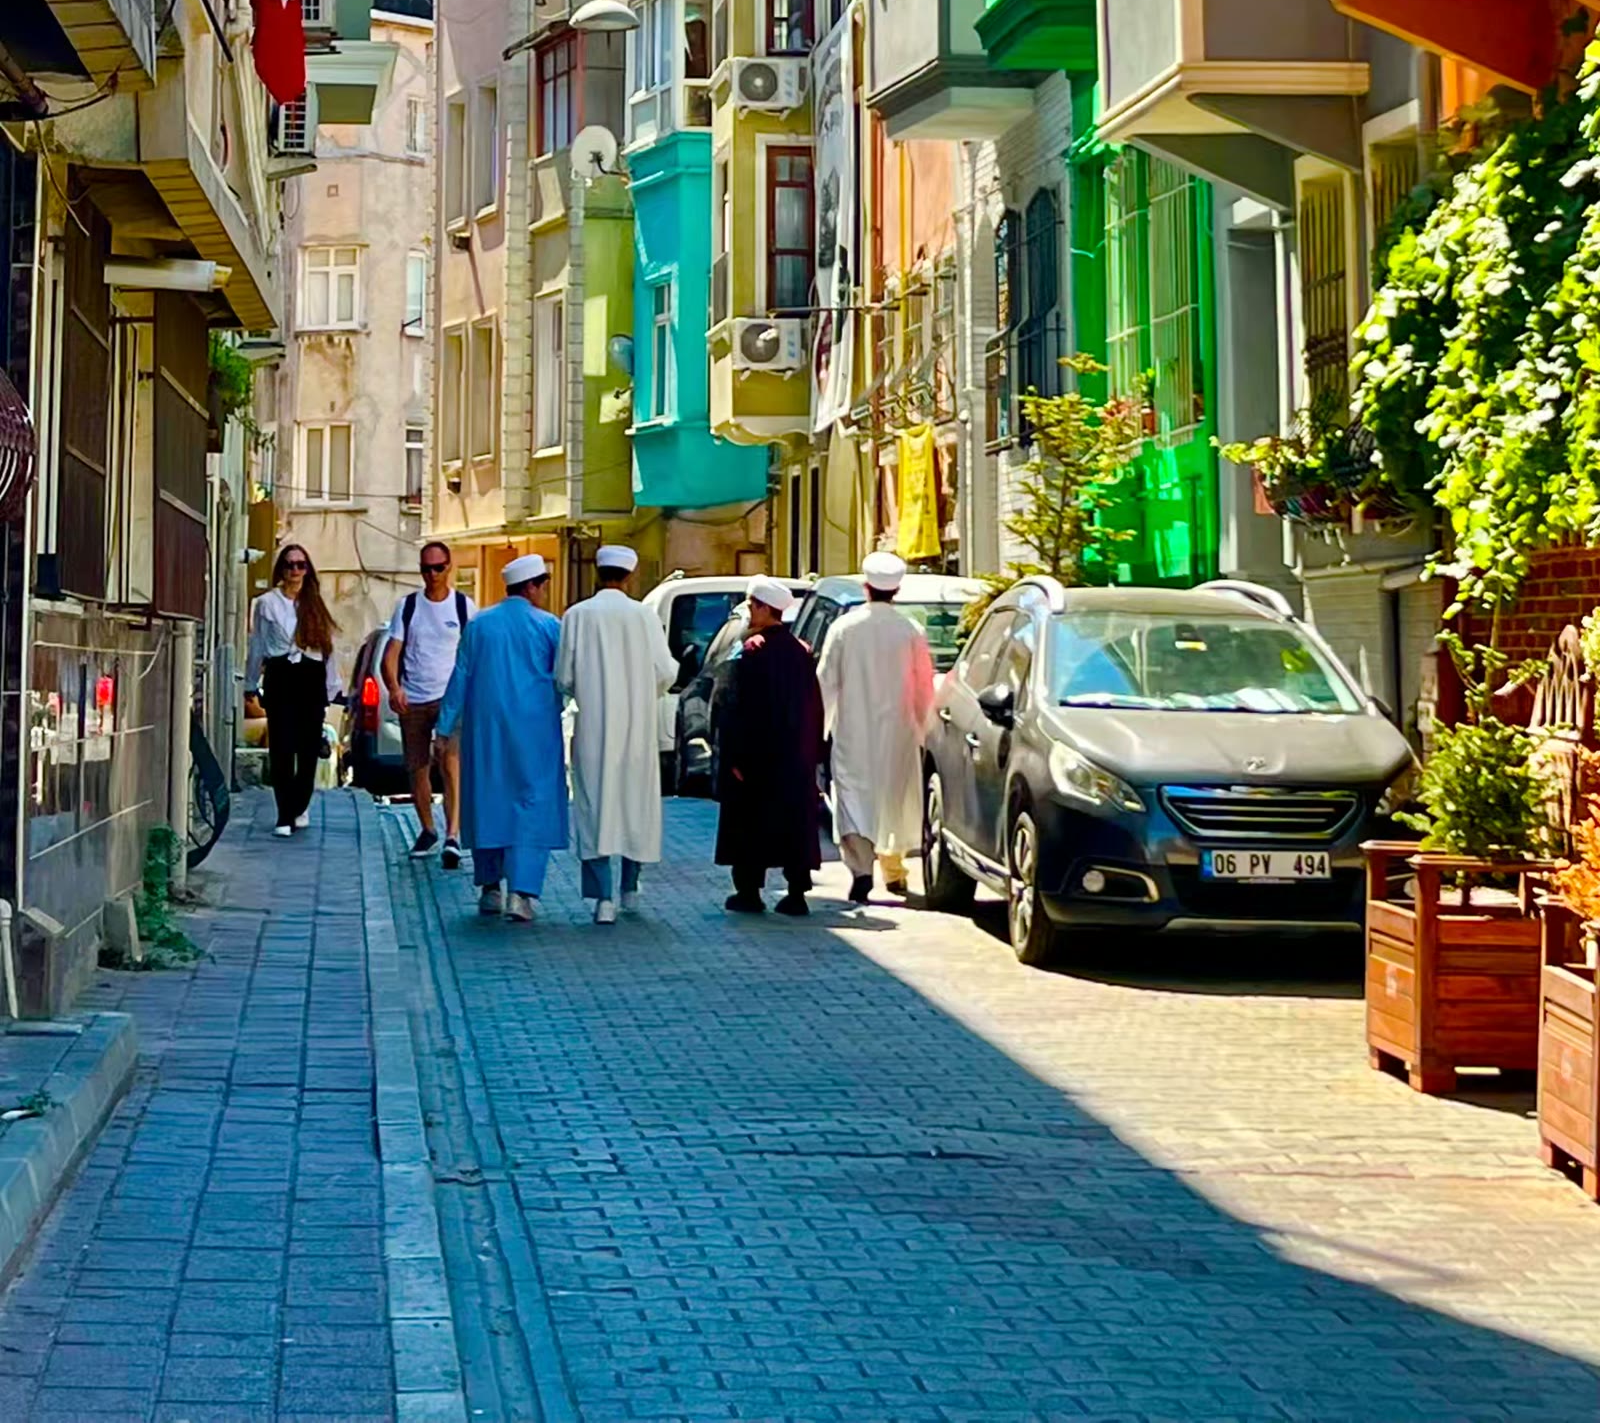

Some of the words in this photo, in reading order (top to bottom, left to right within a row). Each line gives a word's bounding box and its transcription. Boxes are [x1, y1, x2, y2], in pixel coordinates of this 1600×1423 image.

[1214, 853, 1237, 874] 06
[1249, 853, 1271, 875] PY
[1293, 854, 1326, 875] 494
